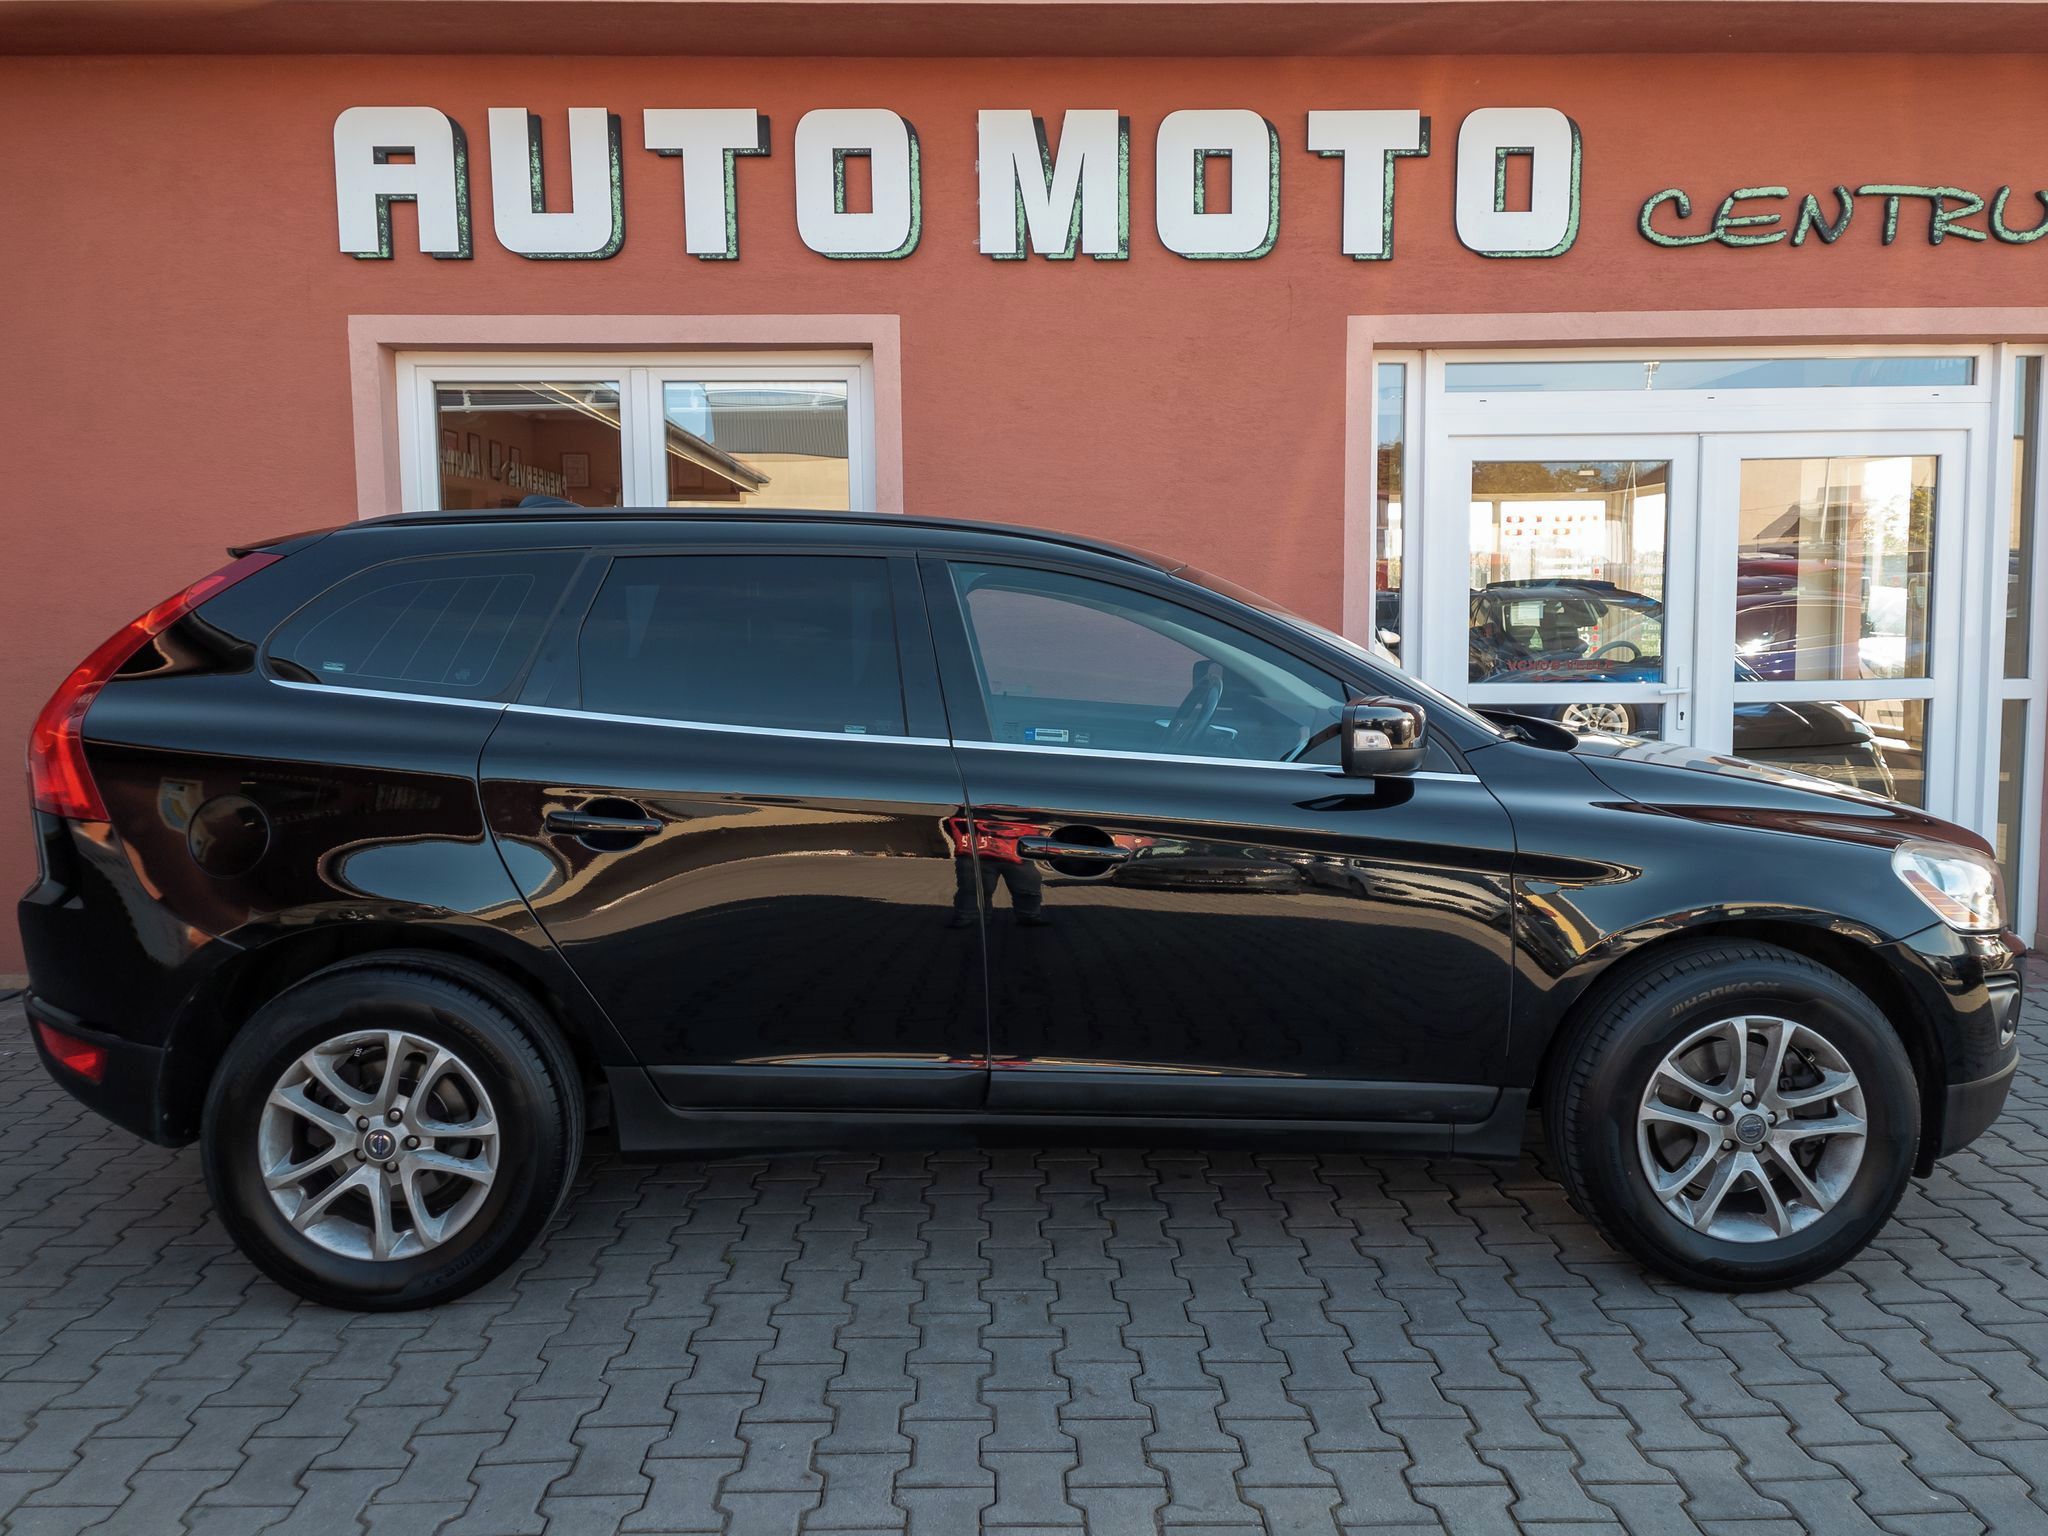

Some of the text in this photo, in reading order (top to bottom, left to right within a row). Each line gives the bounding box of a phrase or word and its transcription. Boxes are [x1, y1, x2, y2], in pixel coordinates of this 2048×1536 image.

[333, 106, 1582, 261] AUTO MOTO
[1637, 184, 2048, 248] CENTRU
